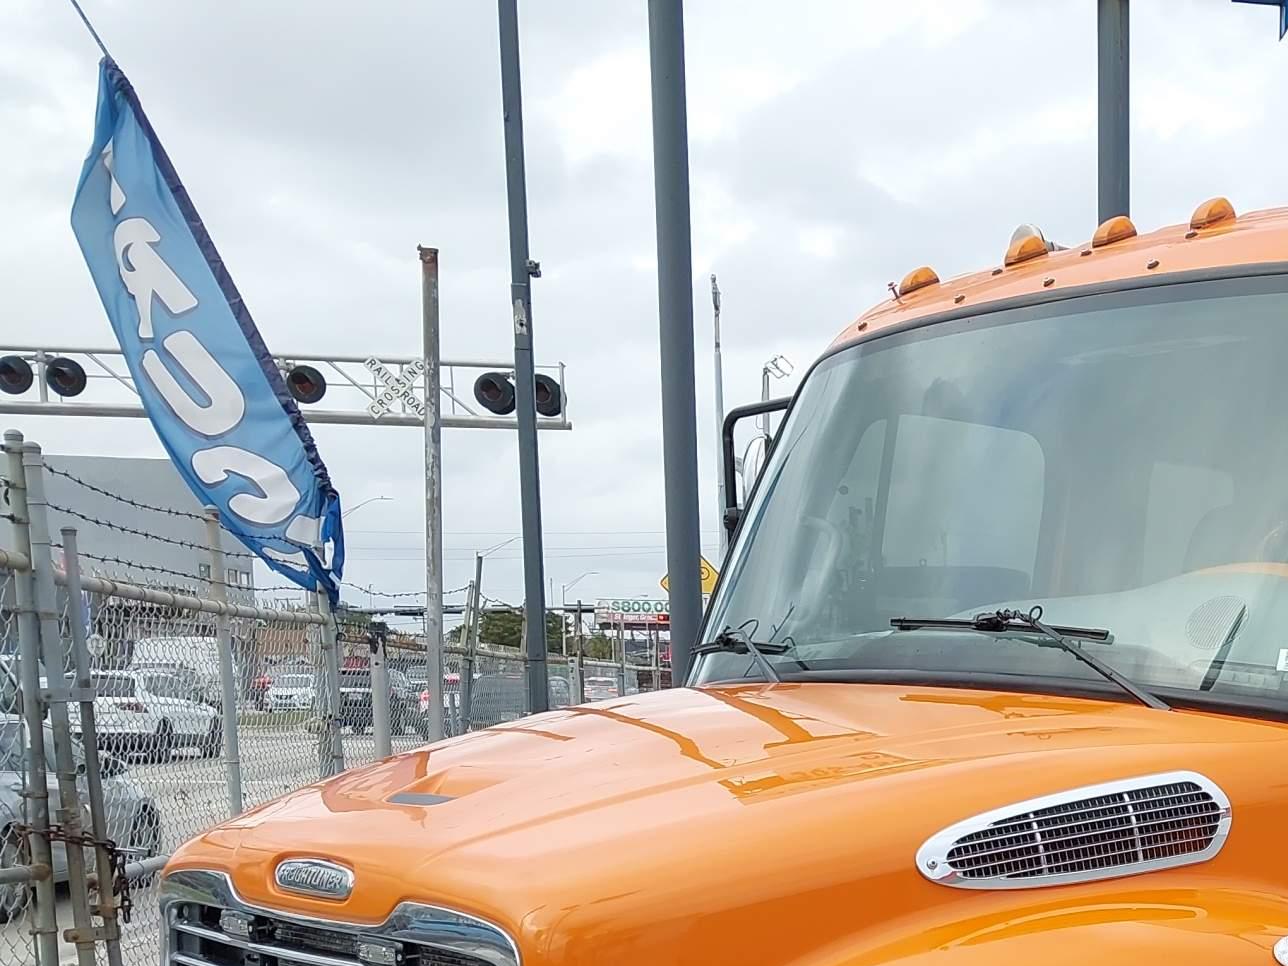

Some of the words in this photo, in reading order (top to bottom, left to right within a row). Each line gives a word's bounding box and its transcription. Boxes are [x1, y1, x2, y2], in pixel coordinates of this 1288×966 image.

[366, 359, 392, 385] RAIL
[400, 390, 424, 416] ROAD
[371, 361, 424, 415] CROSSING
[280, 866, 343, 889] FREIGHTLINER
